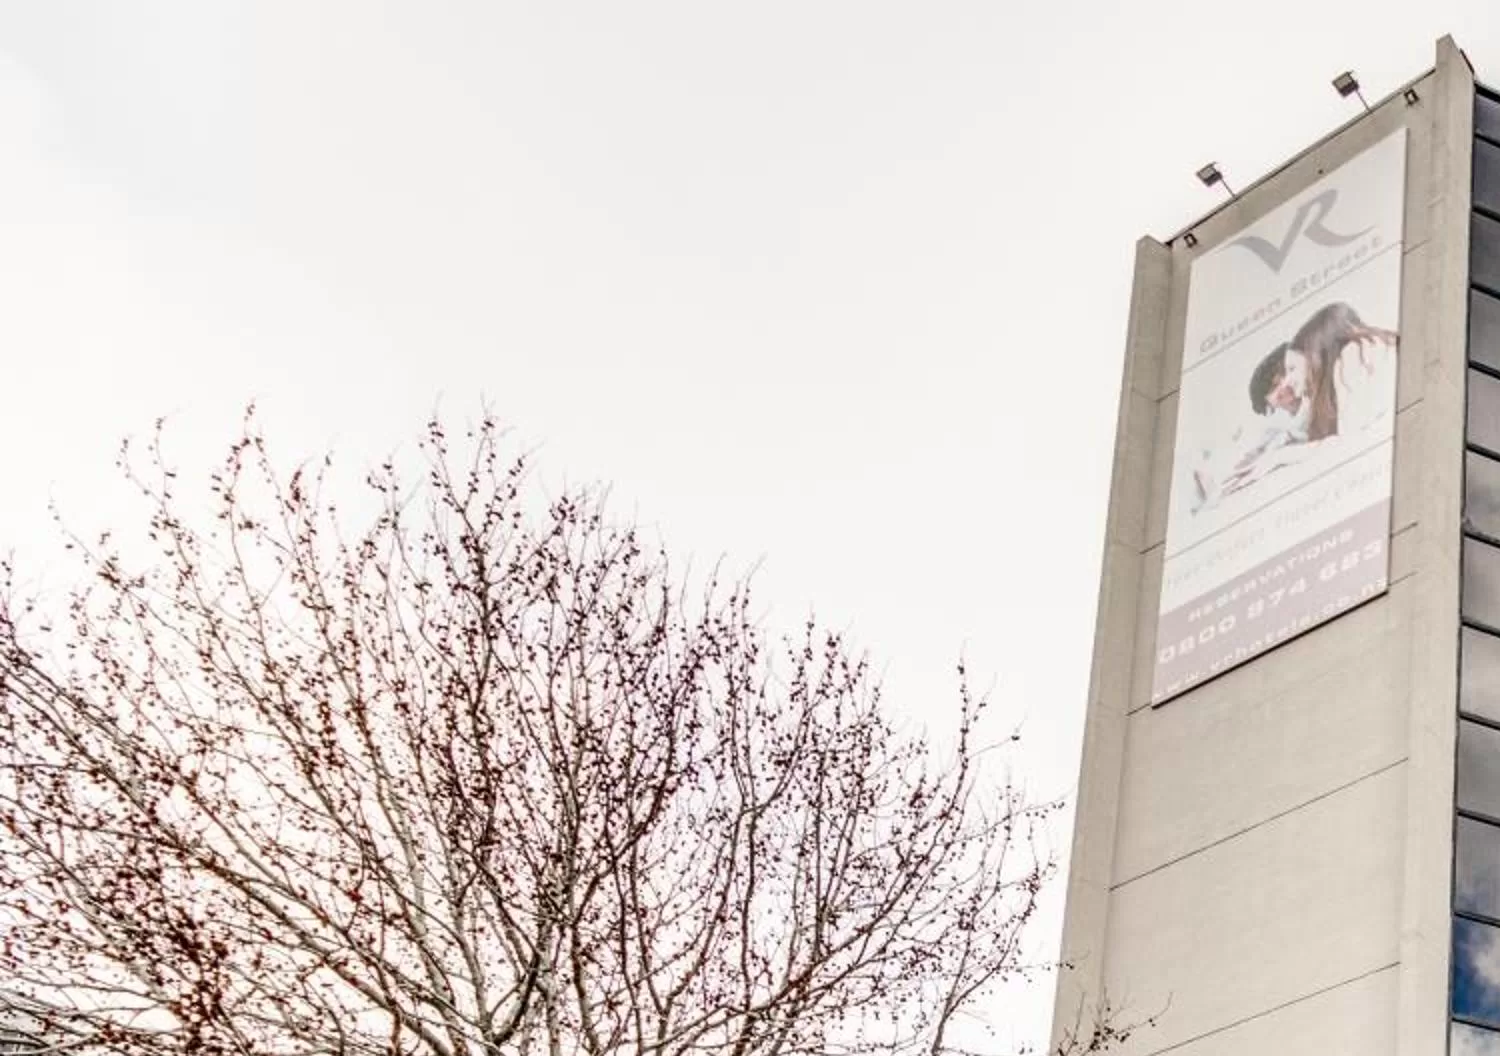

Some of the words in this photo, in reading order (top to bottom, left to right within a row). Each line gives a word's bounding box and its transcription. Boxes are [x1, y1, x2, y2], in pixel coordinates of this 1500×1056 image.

[1199, 297, 1282, 353] Queen
[1188, 528, 1355, 622] RESERVATIONS
[1159, 615, 1237, 665] 0800
